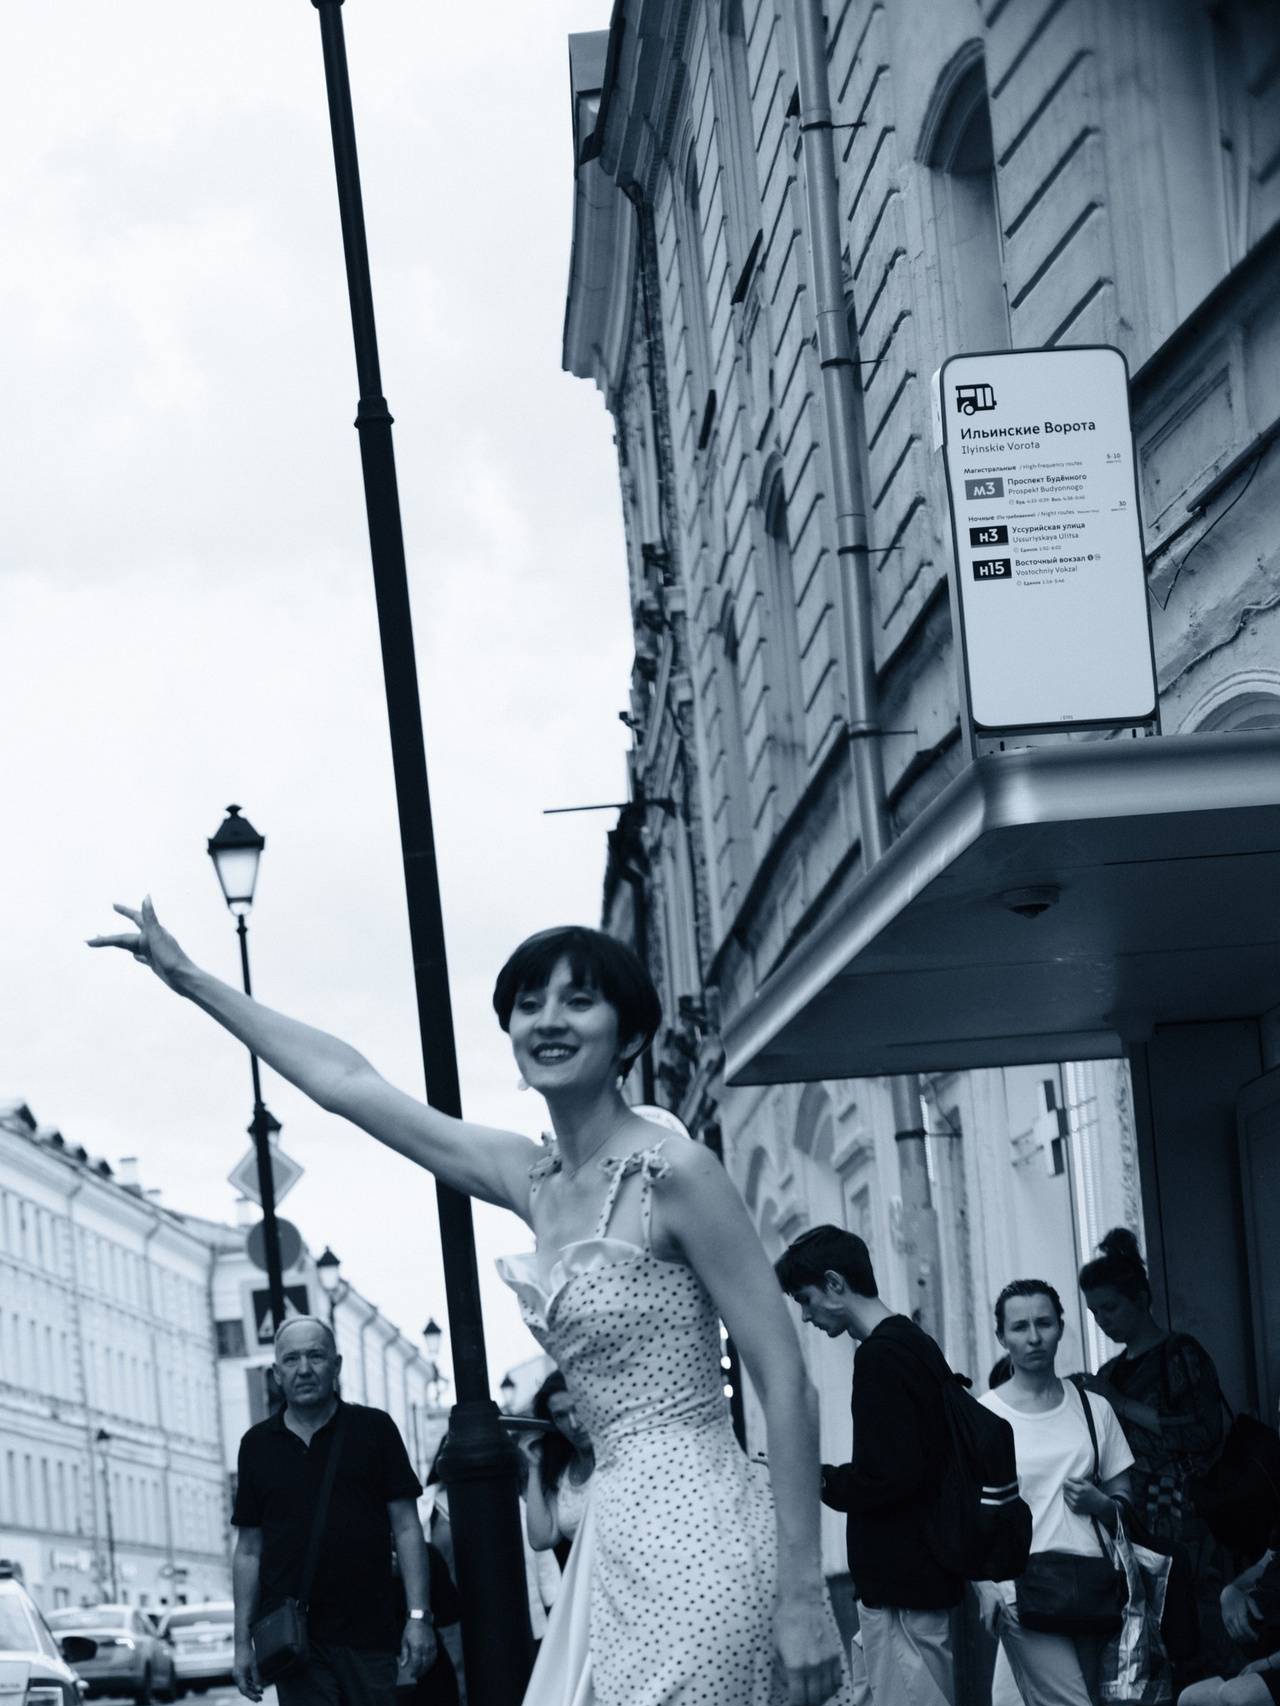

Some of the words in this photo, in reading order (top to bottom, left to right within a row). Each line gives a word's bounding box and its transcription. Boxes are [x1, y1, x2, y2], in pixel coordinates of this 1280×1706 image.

[961, 425, 1040, 440] Ильинские
[1045, 421, 1096, 434] Ворота
[962, 443, 1005, 455] Ilyinskie
[1007, 441, 1040, 451] Vorota
[964, 465, 1016, 474] Магистральные
[1007, 477, 1044, 486] Проспект
[1046, 474, 1087, 484] Будённого
[1008, 487, 1039, 496] Prospekt
[1040, 484, 1083, 494] Budyonnogo
[968, 514, 994, 523] Ночные
[1040, 510, 1057, 518] Night
[1012, 524, 1061, 534] Уссурийская
[1062, 523, 1085, 531] улица
[979, 529, 999, 543] н3
[1013, 534, 1057, 543] Ussuriyskaya
[1059, 532, 1079, 541] Ulitsa
[1015, 557, 1058, 566] Восточный
[979, 562, 1005, 576] н15
[1016, 567, 1054, 576] Vostochniy
[1055, 565, 1078, 573] Vokzal
